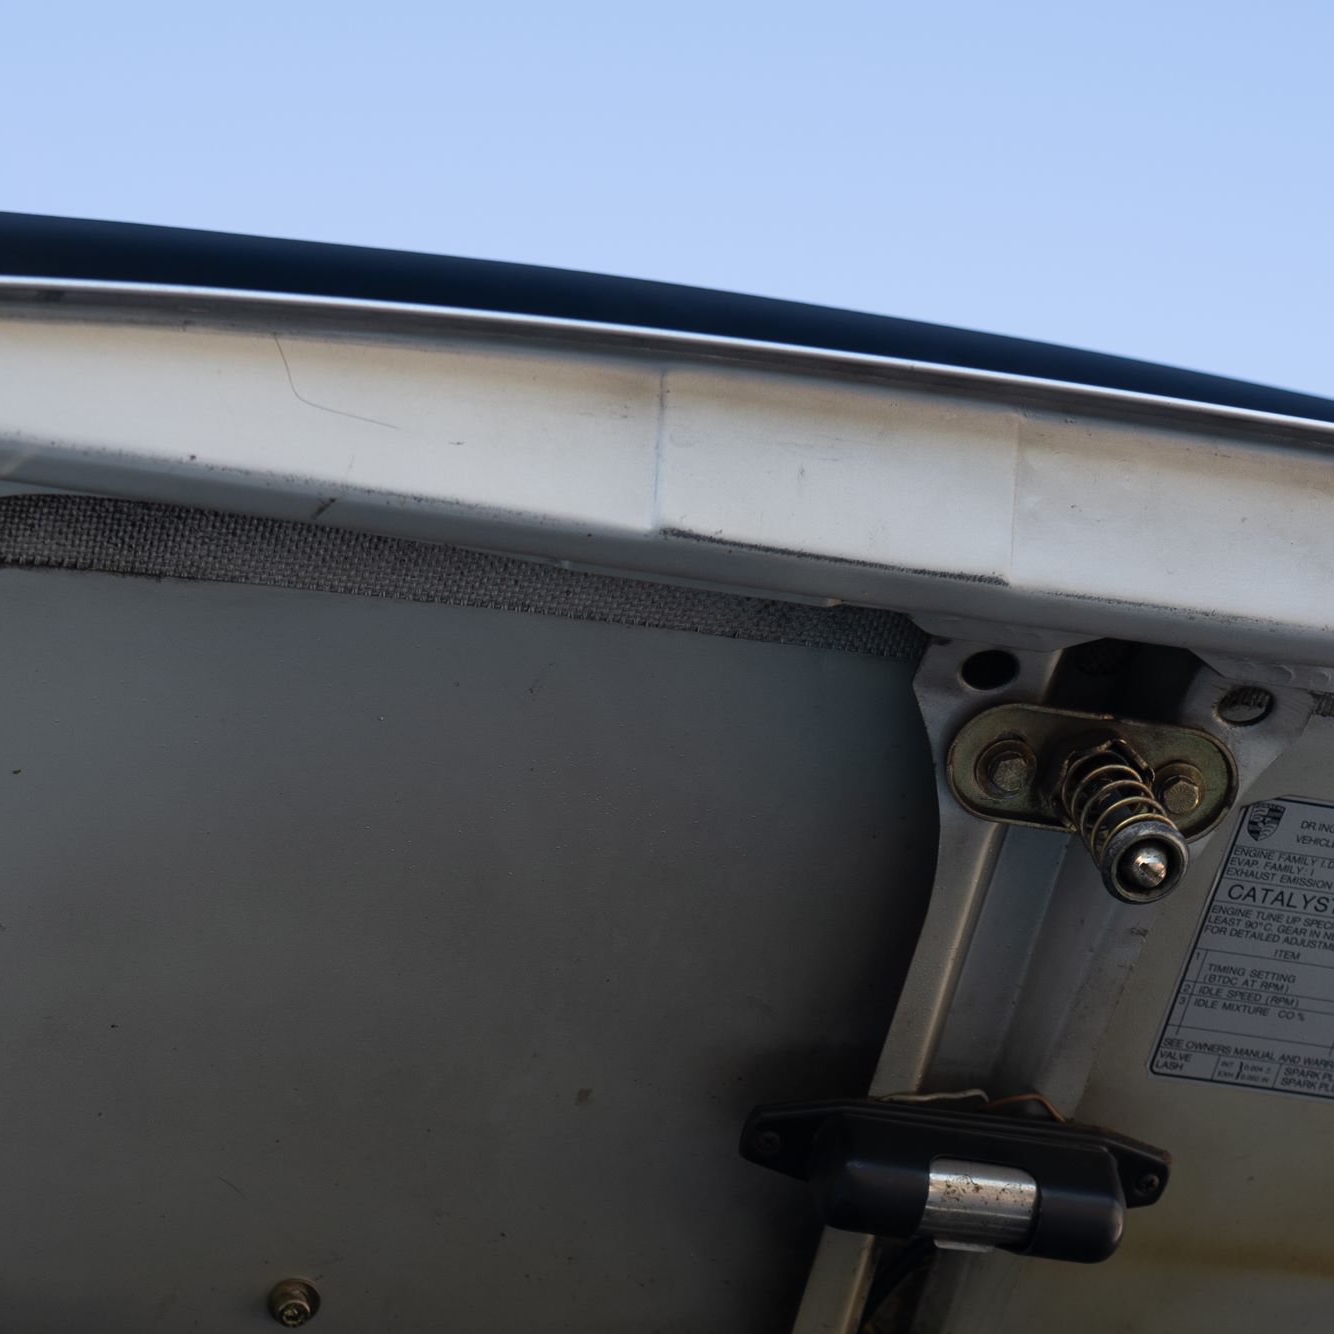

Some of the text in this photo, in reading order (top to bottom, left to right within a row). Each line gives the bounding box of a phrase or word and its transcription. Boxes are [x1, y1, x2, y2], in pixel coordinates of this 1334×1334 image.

[1233, 847, 1275, 860] ENGINE
[1277, 853, 1317, 867] FAMILY
[1225, 866, 1277, 882] EXHAUST
[1279, 874, 1334, 890] EMISSION
[1211, 904, 1253, 918] ENGINE
[1255, 911, 1284, 923] TUNE
[1285, 915, 1301, 925] UP
[1203, 924, 1227, 935] FOR
[1228, 928, 1281, 943] DETAILED
[1207, 914, 1241, 927] LEAST
[1276, 924, 1307, 937] GEAR
[1308, 929, 1321, 939] IN
[1273, 949, 1301, 960] ITEM
[1202, 973, 1290, 993] (BTDC AT RPM)
[1206, 963, 1297, 983] TIMING SETTING
[1197, 985, 1300, 1008] IDLE SPEED (RPM)
[1193, 997, 1296, 1020] IDLE MIXTURE CO
[1157, 1049, 1192, 1062] VALVE
[1161, 1037, 1183, 1048] SEE
[1184, 1040, 1232, 1054] OWNERS
[1278, 1053, 1301, 1063] AND
[1154, 1059, 1184, 1071] LASH
[1283, 1066, 1322, 1080] SPARK
[1279, 1076, 1318, 1090] SPARK
